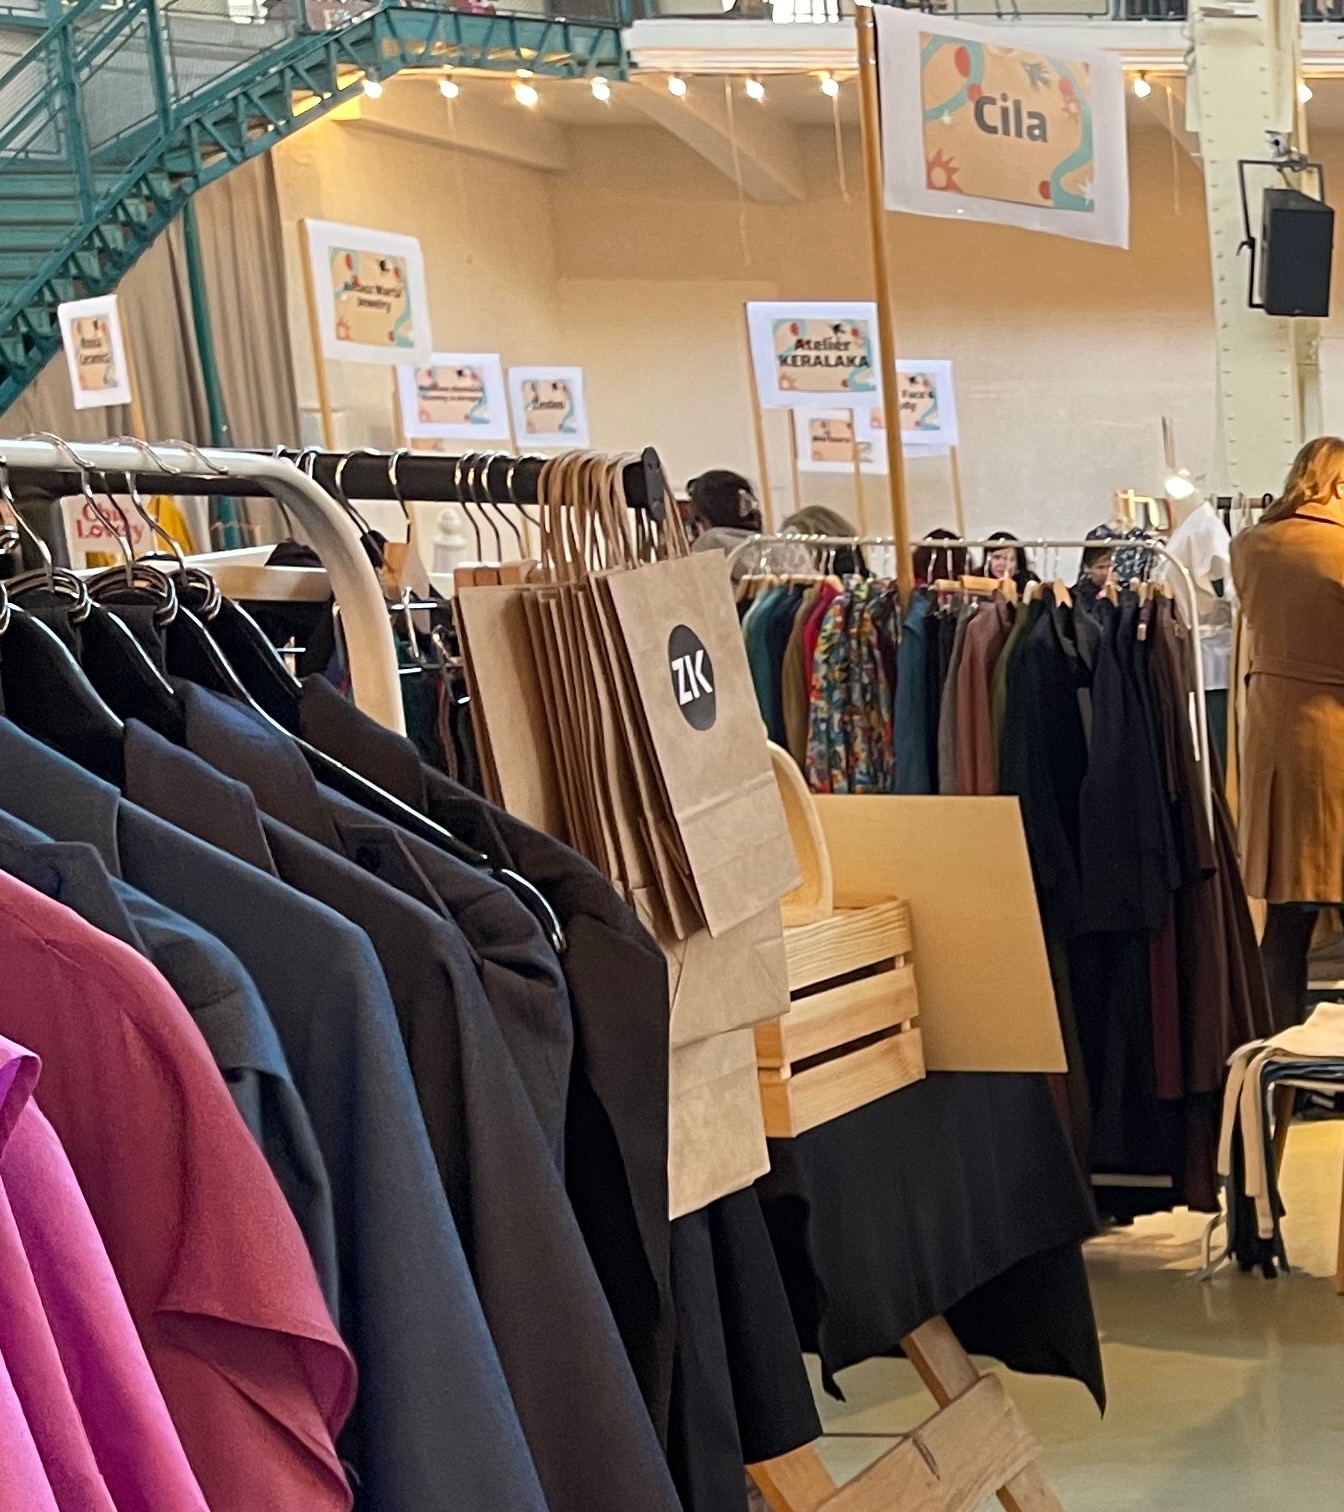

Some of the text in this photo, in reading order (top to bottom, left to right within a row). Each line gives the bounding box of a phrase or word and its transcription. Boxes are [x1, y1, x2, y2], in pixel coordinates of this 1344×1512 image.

[974, 92, 1048, 143] Cila
[794, 337, 852, 351] Atelier
[778, 355, 871, 368] KERALAKA
[671, 649, 713, 705] ZK
